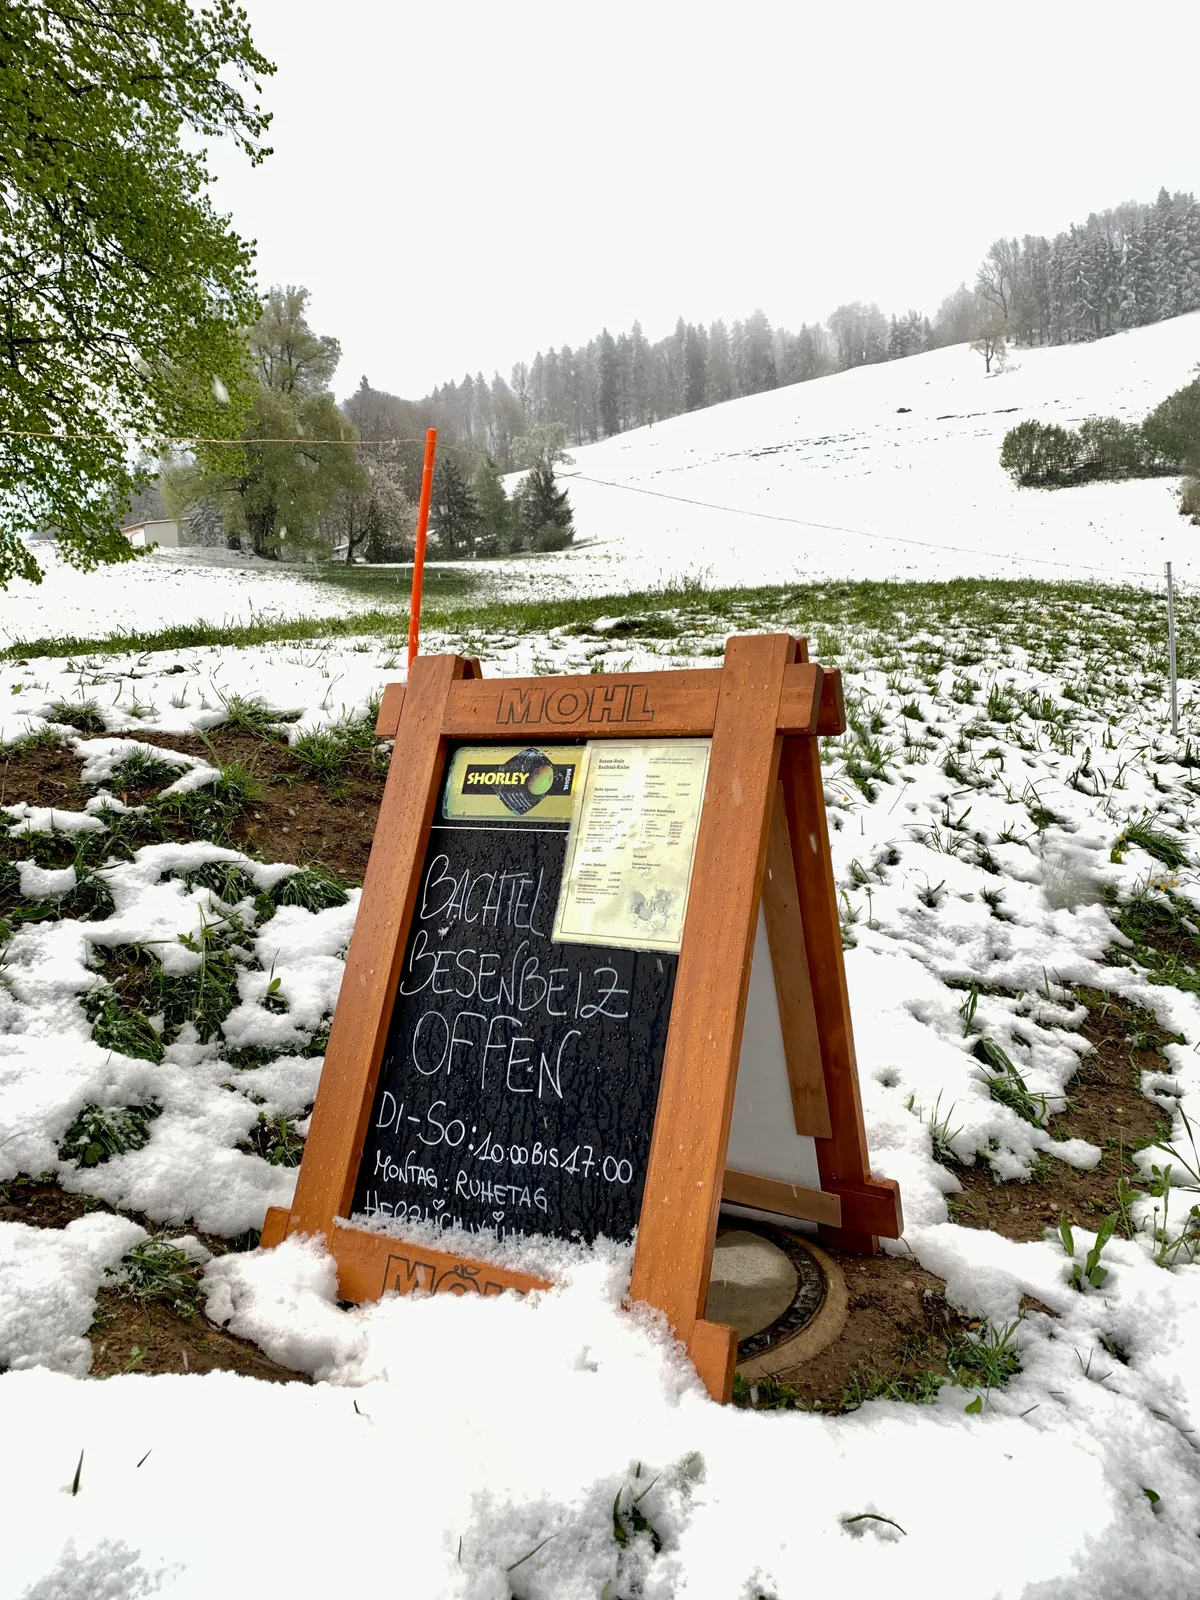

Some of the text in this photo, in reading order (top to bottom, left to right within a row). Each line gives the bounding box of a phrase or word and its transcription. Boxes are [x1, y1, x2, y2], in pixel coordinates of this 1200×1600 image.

[496, 684, 655, 725] MOHL
[466, 772, 530, 785] SHORLEY
[562, 768, 572, 791] MOHL
[420, 854, 544, 936] BACHTEL
[412, 1011, 581, 1099] OFFEN
[474, 1132, 528, 1164] 10:00
[531, 1142, 559, 1168] BIS
[560, 1145, 633, 1184] 17:00
[455, 1170, 548, 1213] RUHETAG
